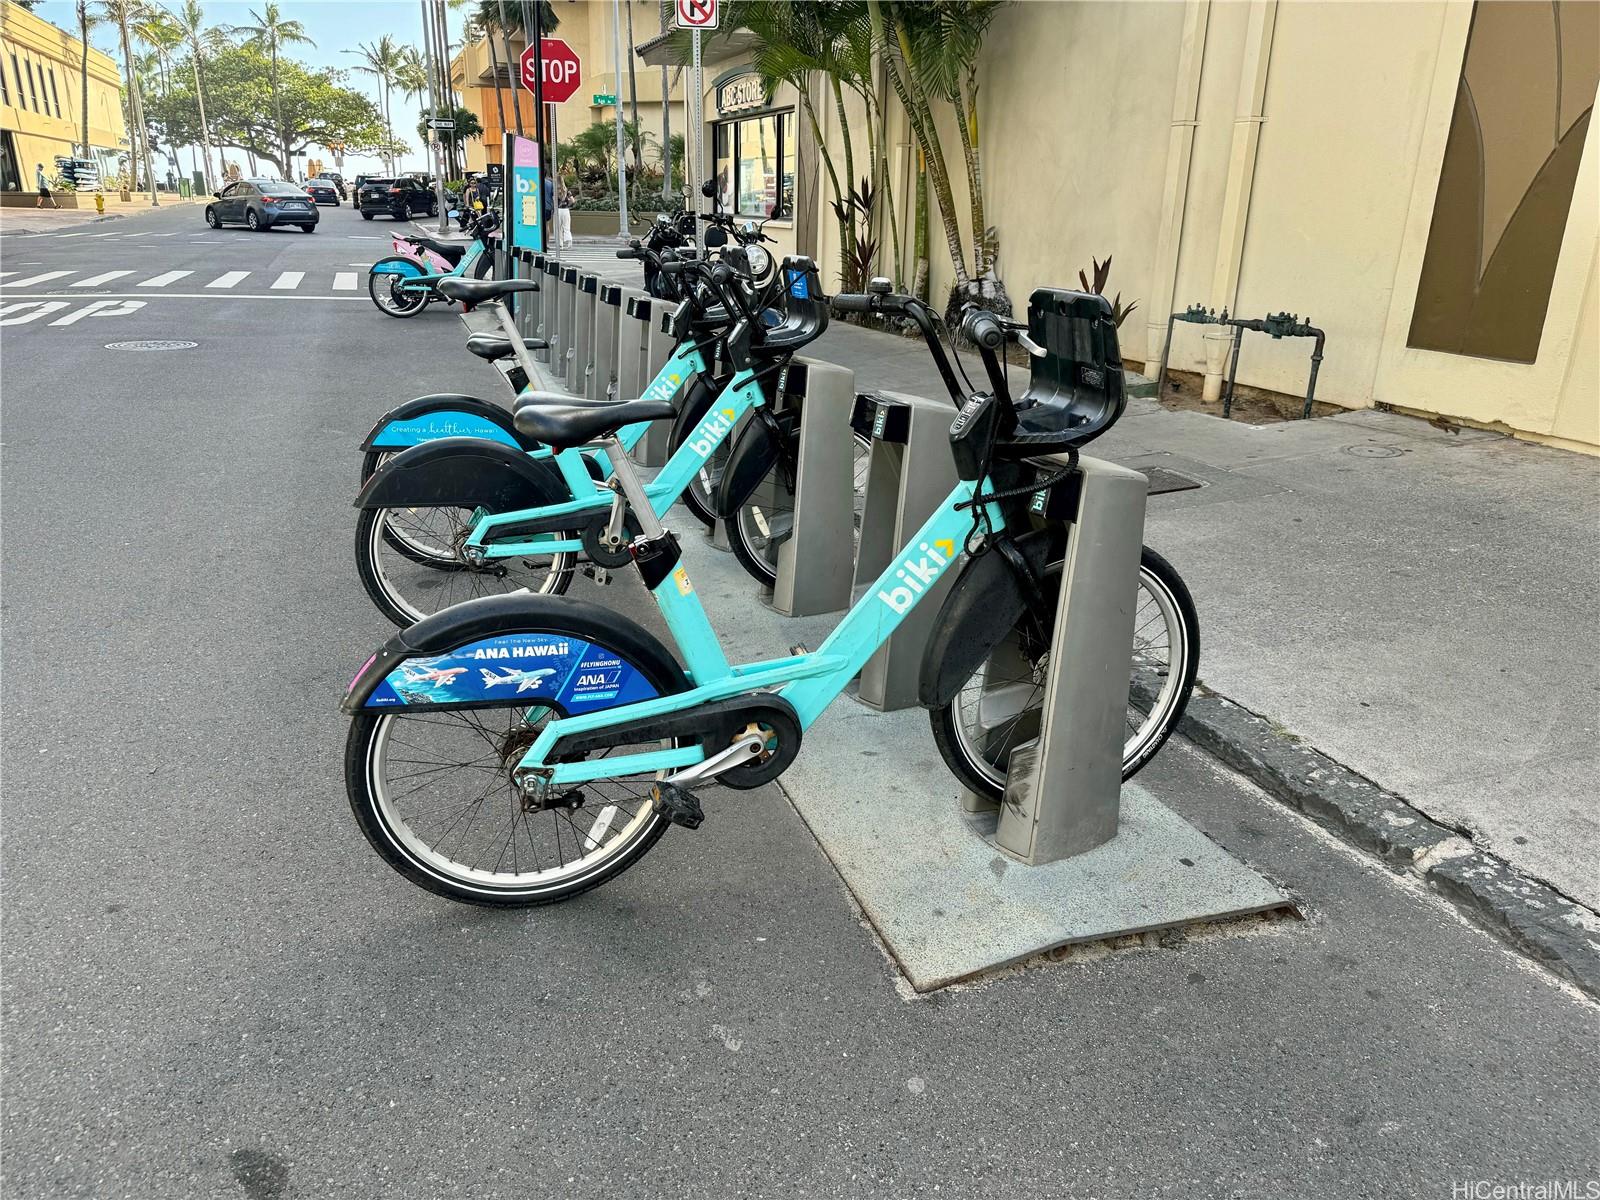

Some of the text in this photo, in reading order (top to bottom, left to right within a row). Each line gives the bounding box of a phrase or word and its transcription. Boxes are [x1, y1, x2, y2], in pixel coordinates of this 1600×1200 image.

[526, 58, 577, 83] STOP
[722, 85, 737, 107] ABC
[0, 301, 148, 326] OP
[650, 376, 677, 401] iki
[688, 410, 731, 458] biki
[874, 414, 885, 435] biki
[1033, 489, 1046, 511] bik
[877, 542, 947, 615] biki
[474, 647, 510, 660] ANA
[577, 674, 605, 686] ANA
